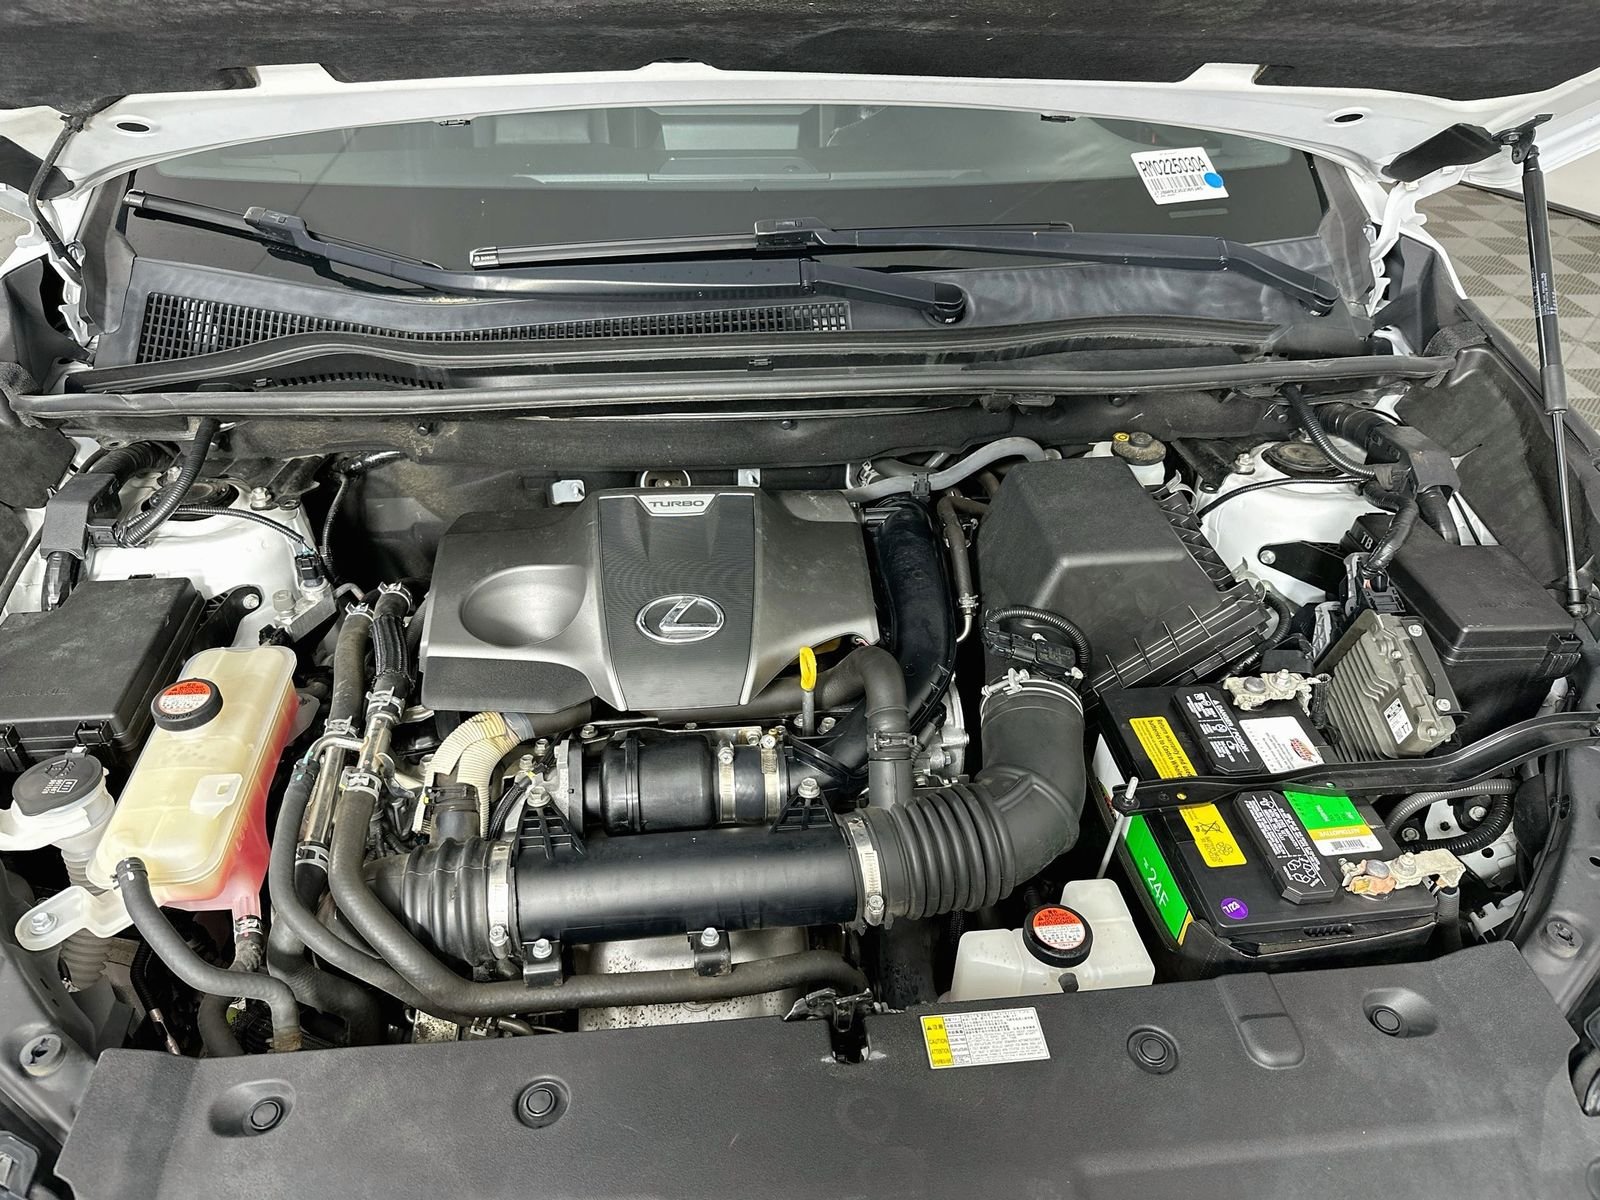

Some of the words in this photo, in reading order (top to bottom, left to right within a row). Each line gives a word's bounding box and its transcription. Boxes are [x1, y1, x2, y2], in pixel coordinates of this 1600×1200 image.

[1138, 156, 1209, 178] RM0225030A
[648, 500, 705, 508] TURBO
[1360, 531, 1374, 550] TB
[1148, 720, 1161, 740] batteries
[1161, 744, 1174, 760] Costco
[1156, 719, 1169, 735] Return
[1165, 734, 1180, 756] warranty
